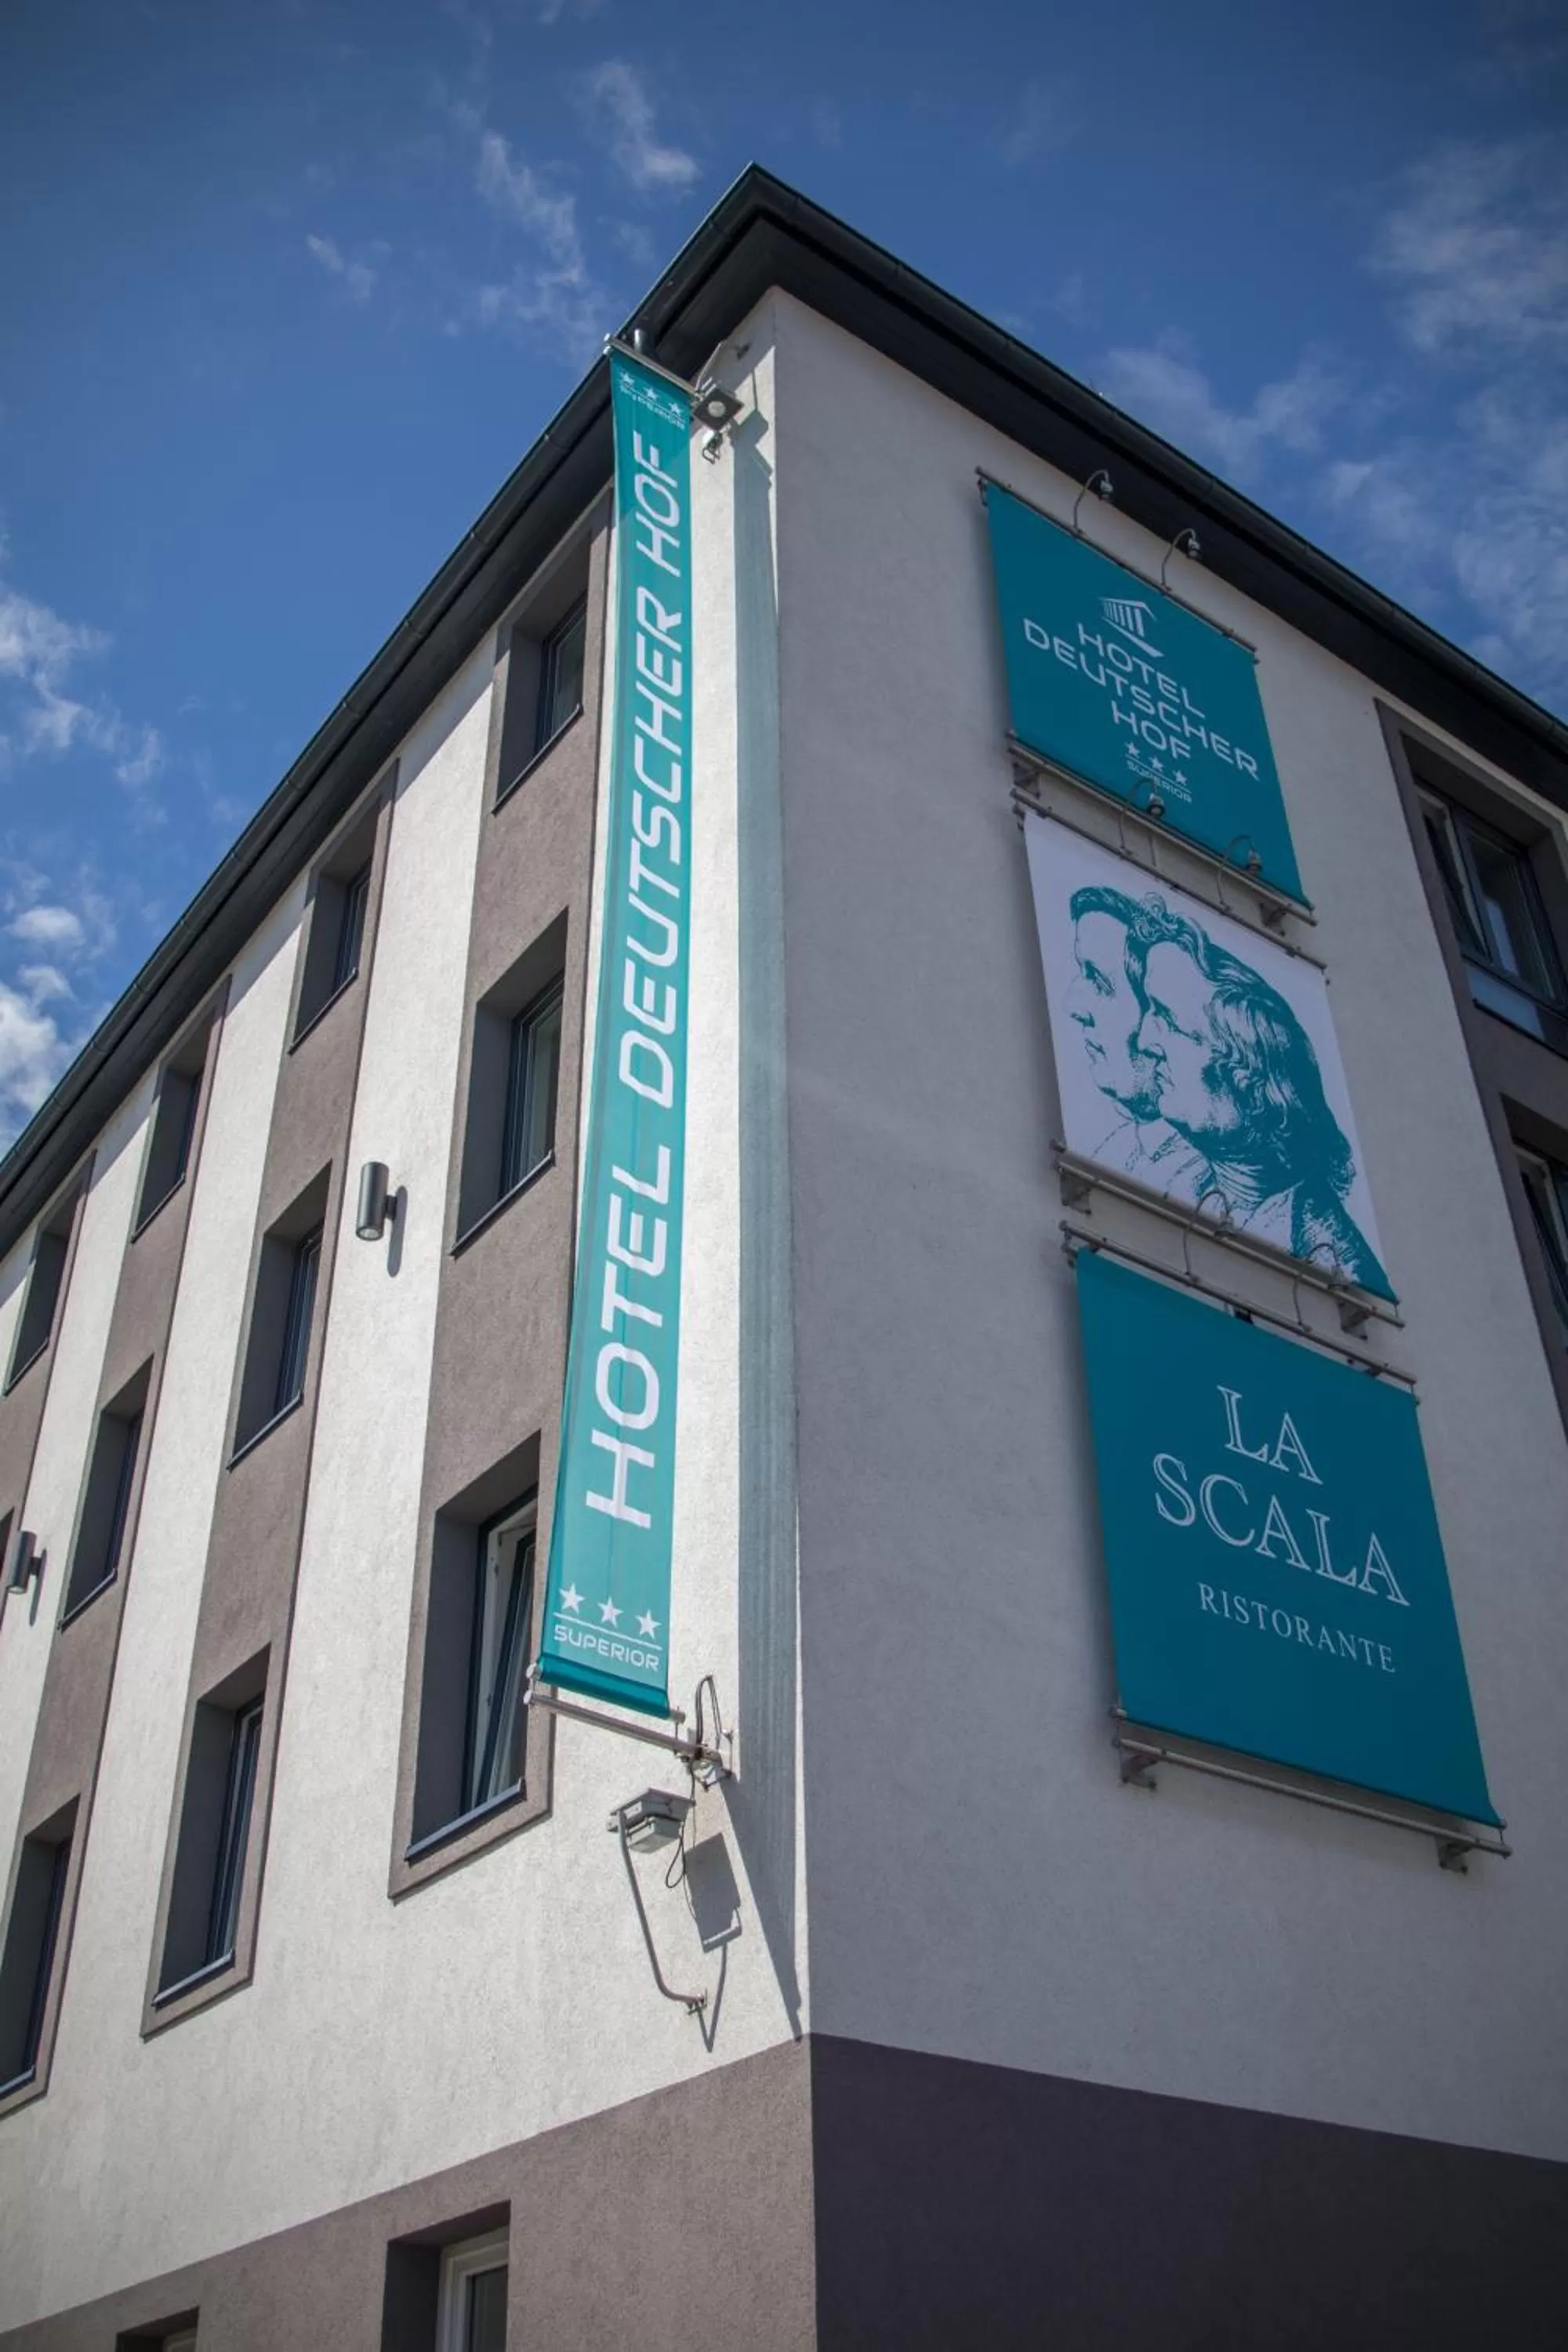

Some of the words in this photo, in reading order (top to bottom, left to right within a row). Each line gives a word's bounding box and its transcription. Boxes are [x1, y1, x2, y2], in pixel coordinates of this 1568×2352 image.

[633, 430, 681, 578] HOF
[1023, 618, 1260, 781] DEUTSCHER
[1077, 622, 1205, 719] HOTEL
[1111, 700, 1191, 759] HOF
[619, 586, 684, 1109] DEUTSCHER
[586, 1145, 671, 1530] HOTEL
[1216, 1385, 1323, 1485] LA
[1152, 1453, 1410, 1606] SCALA
[554, 1624, 659, 1671] SUPERIOR
[1198, 1581, 1396, 1673] RISTORANTE
